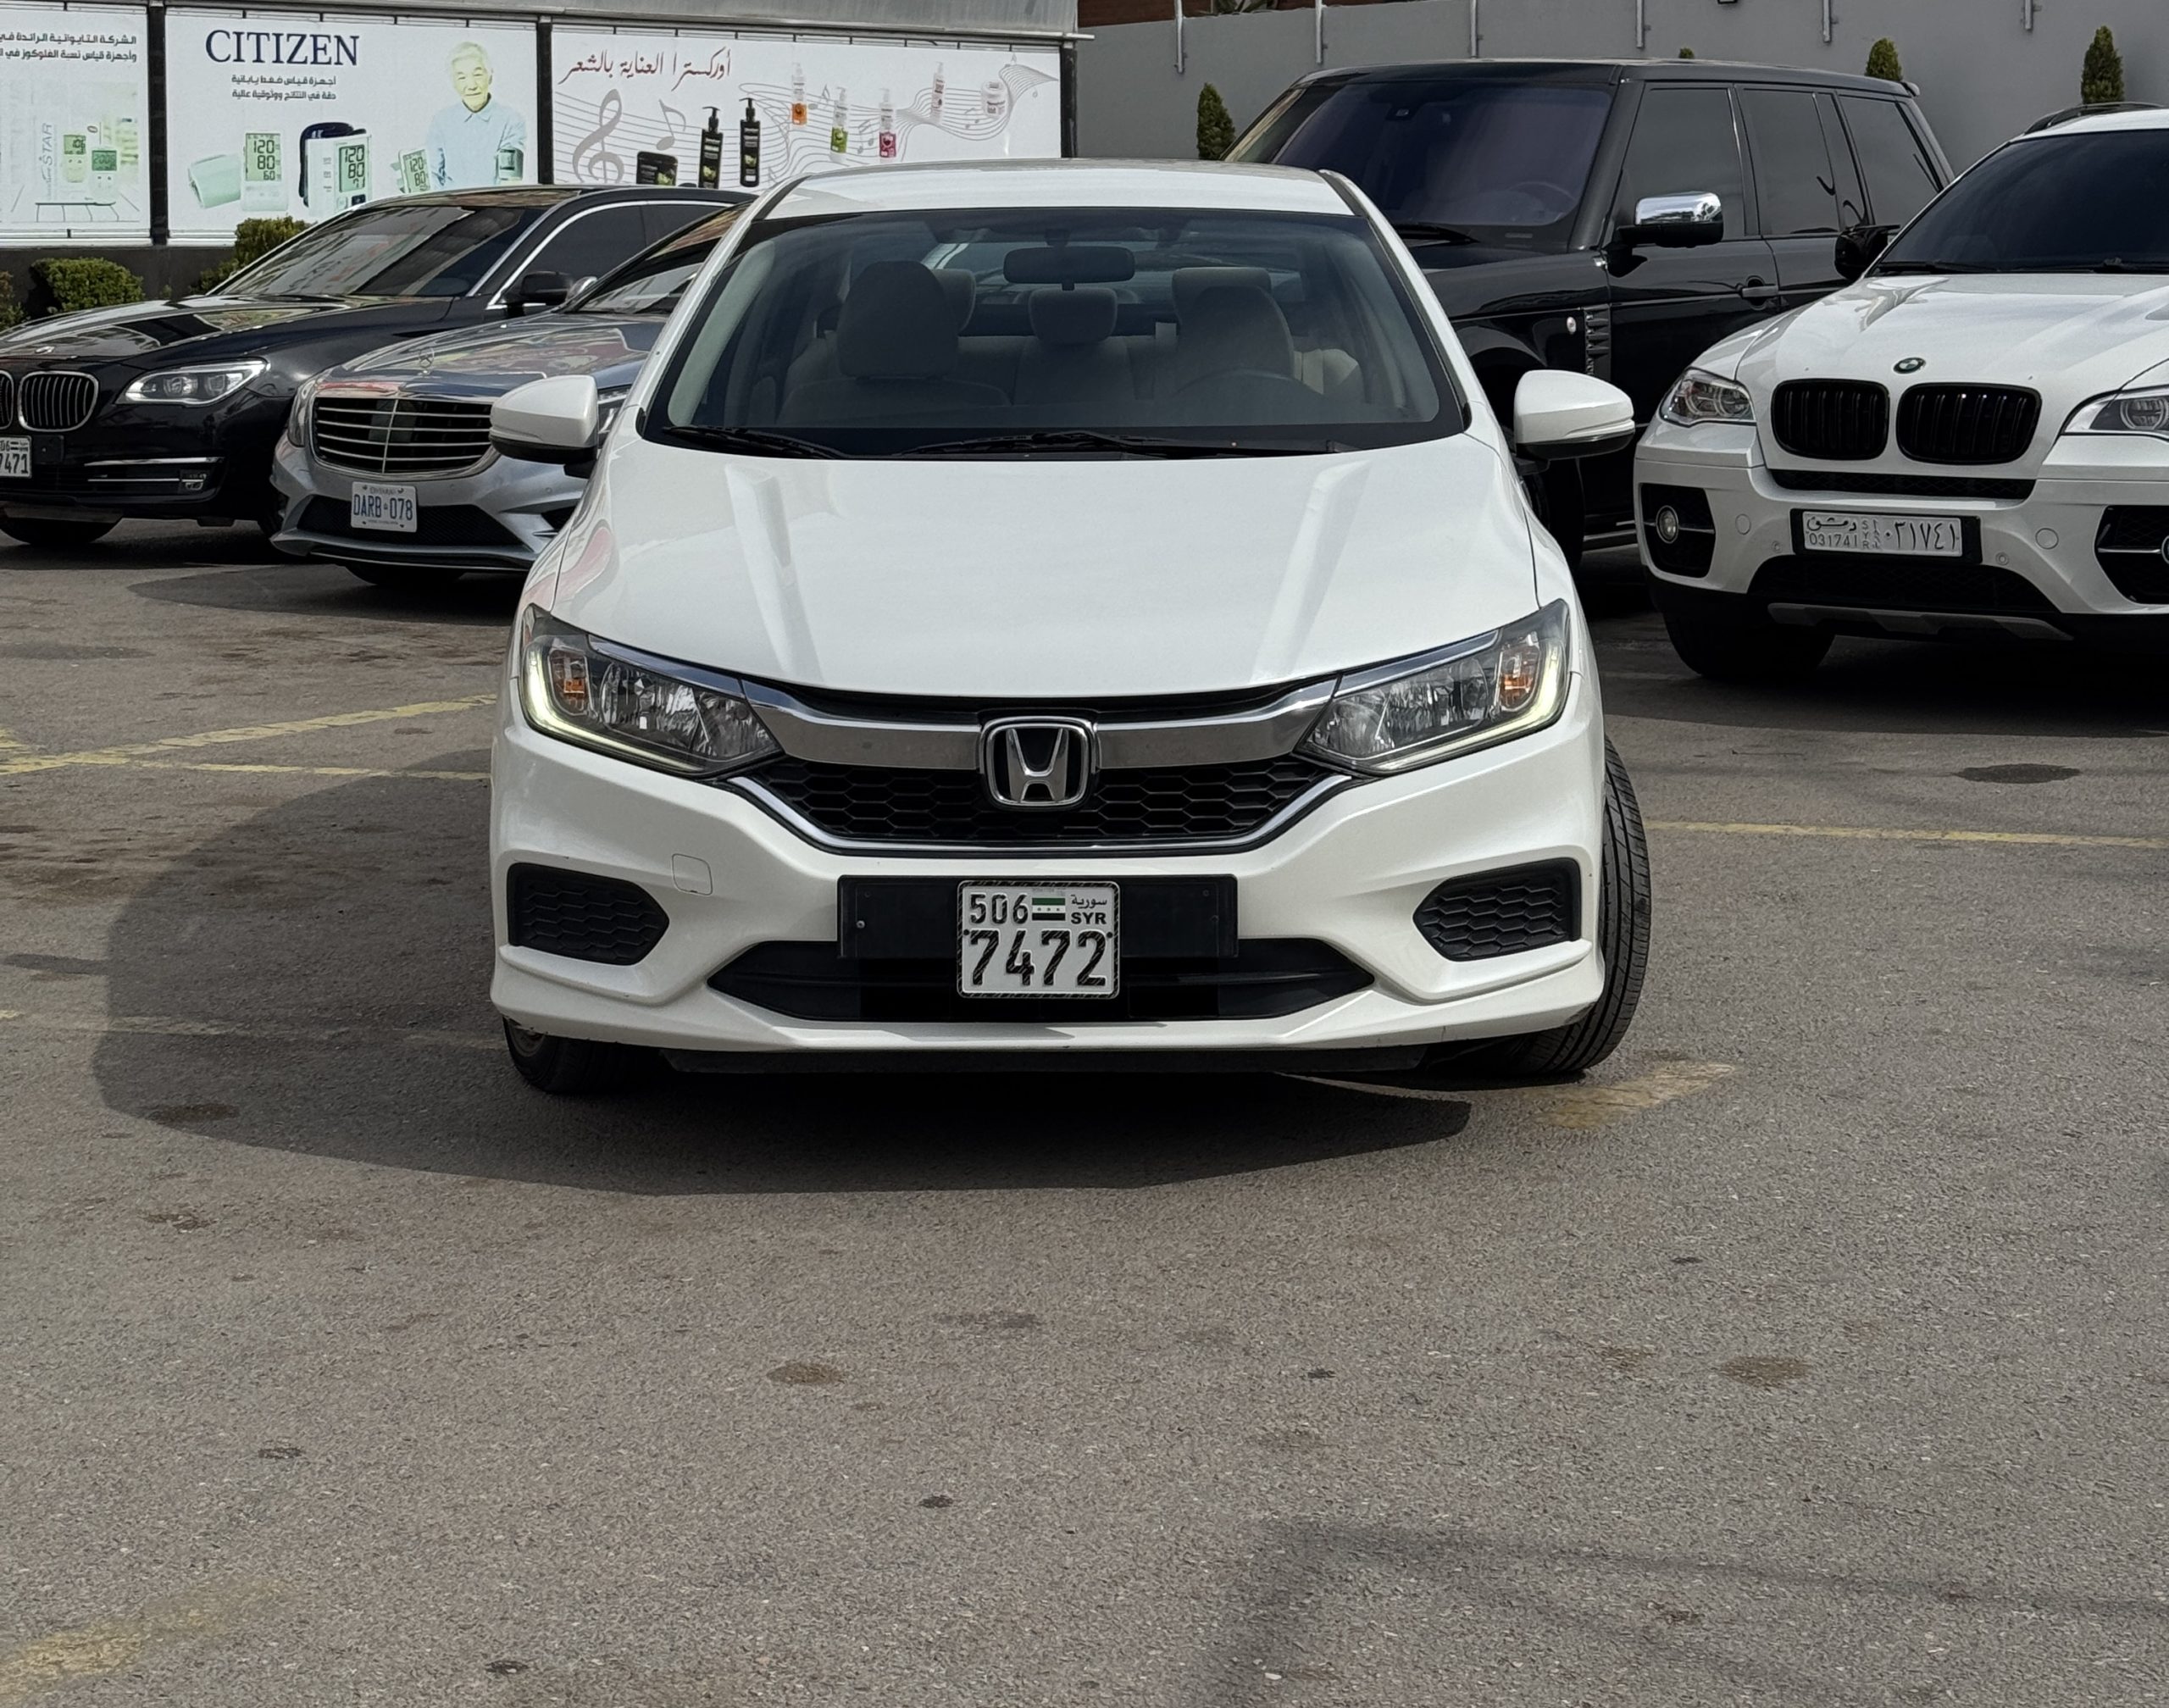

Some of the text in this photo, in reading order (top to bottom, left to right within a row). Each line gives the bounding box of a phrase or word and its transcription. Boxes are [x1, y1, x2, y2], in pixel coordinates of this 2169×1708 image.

[100, 35, 136, 47] الشركة
[205, 30, 360, 66] CITIZEN
[82, 51, 104, 62] قياس
[558, 49, 613, 85] بالشعر
[620, 50, 664, 79] العناية
[260, 75, 283, 85] ضغط
[284, 76, 308, 86] قياس
[308, 75, 336, 87] أجهزة
[232, 89, 251, 100] عالية
[308, 91, 320, 102] في
[321, 91, 336, 100] دقة
[253, 139, 275, 154] 120
[257, 155, 275, 170] 80
[345, 147, 365, 163] 120
[347, 162, 365, 179] 80
[409, 156, 424, 172] 120
[263, 170, 275, 181] 60
[413, 171, 426, 186] 80
[1806, 516, 1857, 532] دمشق
[1808, 532, 1858, 548] 031741
[970, 893, 1029, 925] 506
[1070, 894, 1108, 909] سورية
[1070, 912, 1107, 925] SYR
[970, 929, 1107, 986] 7472
